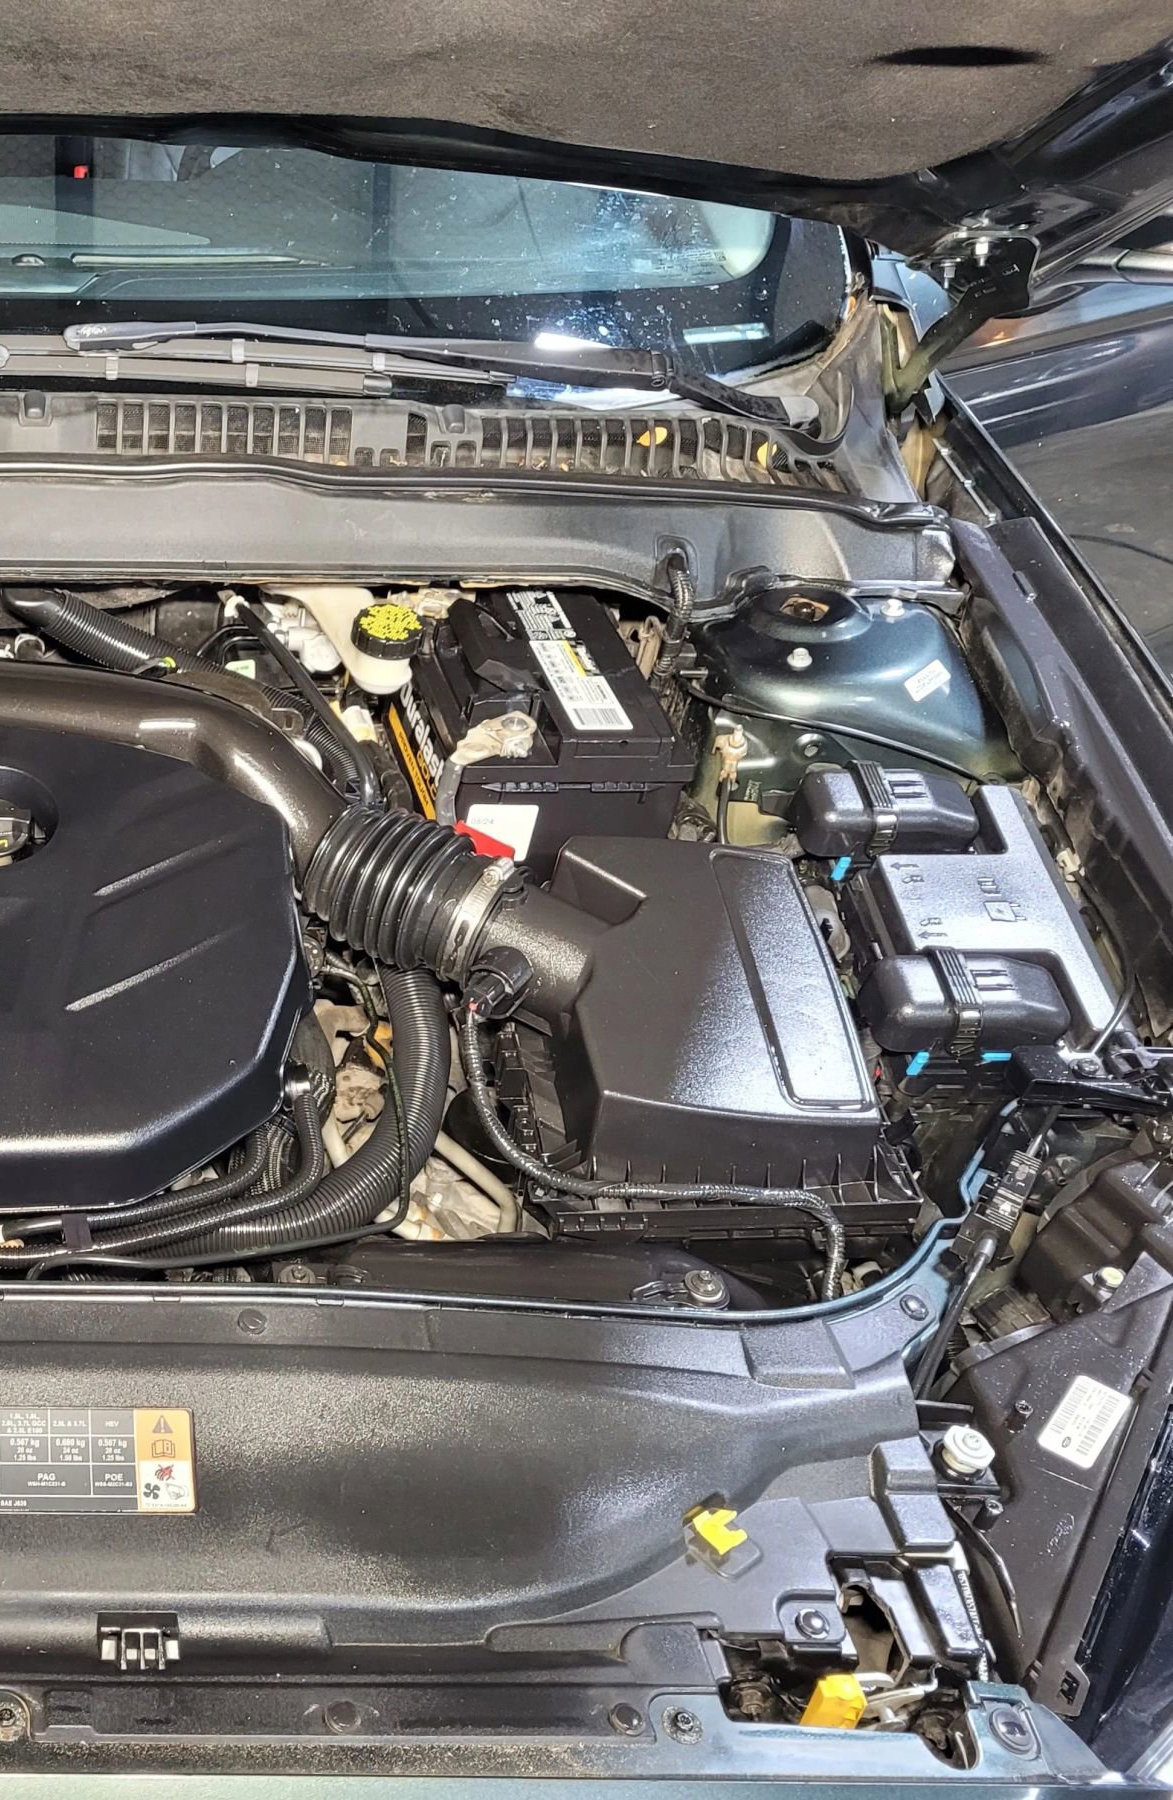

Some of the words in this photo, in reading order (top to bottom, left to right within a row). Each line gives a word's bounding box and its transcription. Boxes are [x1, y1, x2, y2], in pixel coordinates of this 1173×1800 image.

[399, 680, 445, 788] Duralast
[30, 1438, 40, 1448] kg
[76, 1438, 86, 1448] kg
[118, 1438, 128, 1448] kg
[37, 1473, 56, 1481] PAG
[104, 1473, 124, 1481] POE
